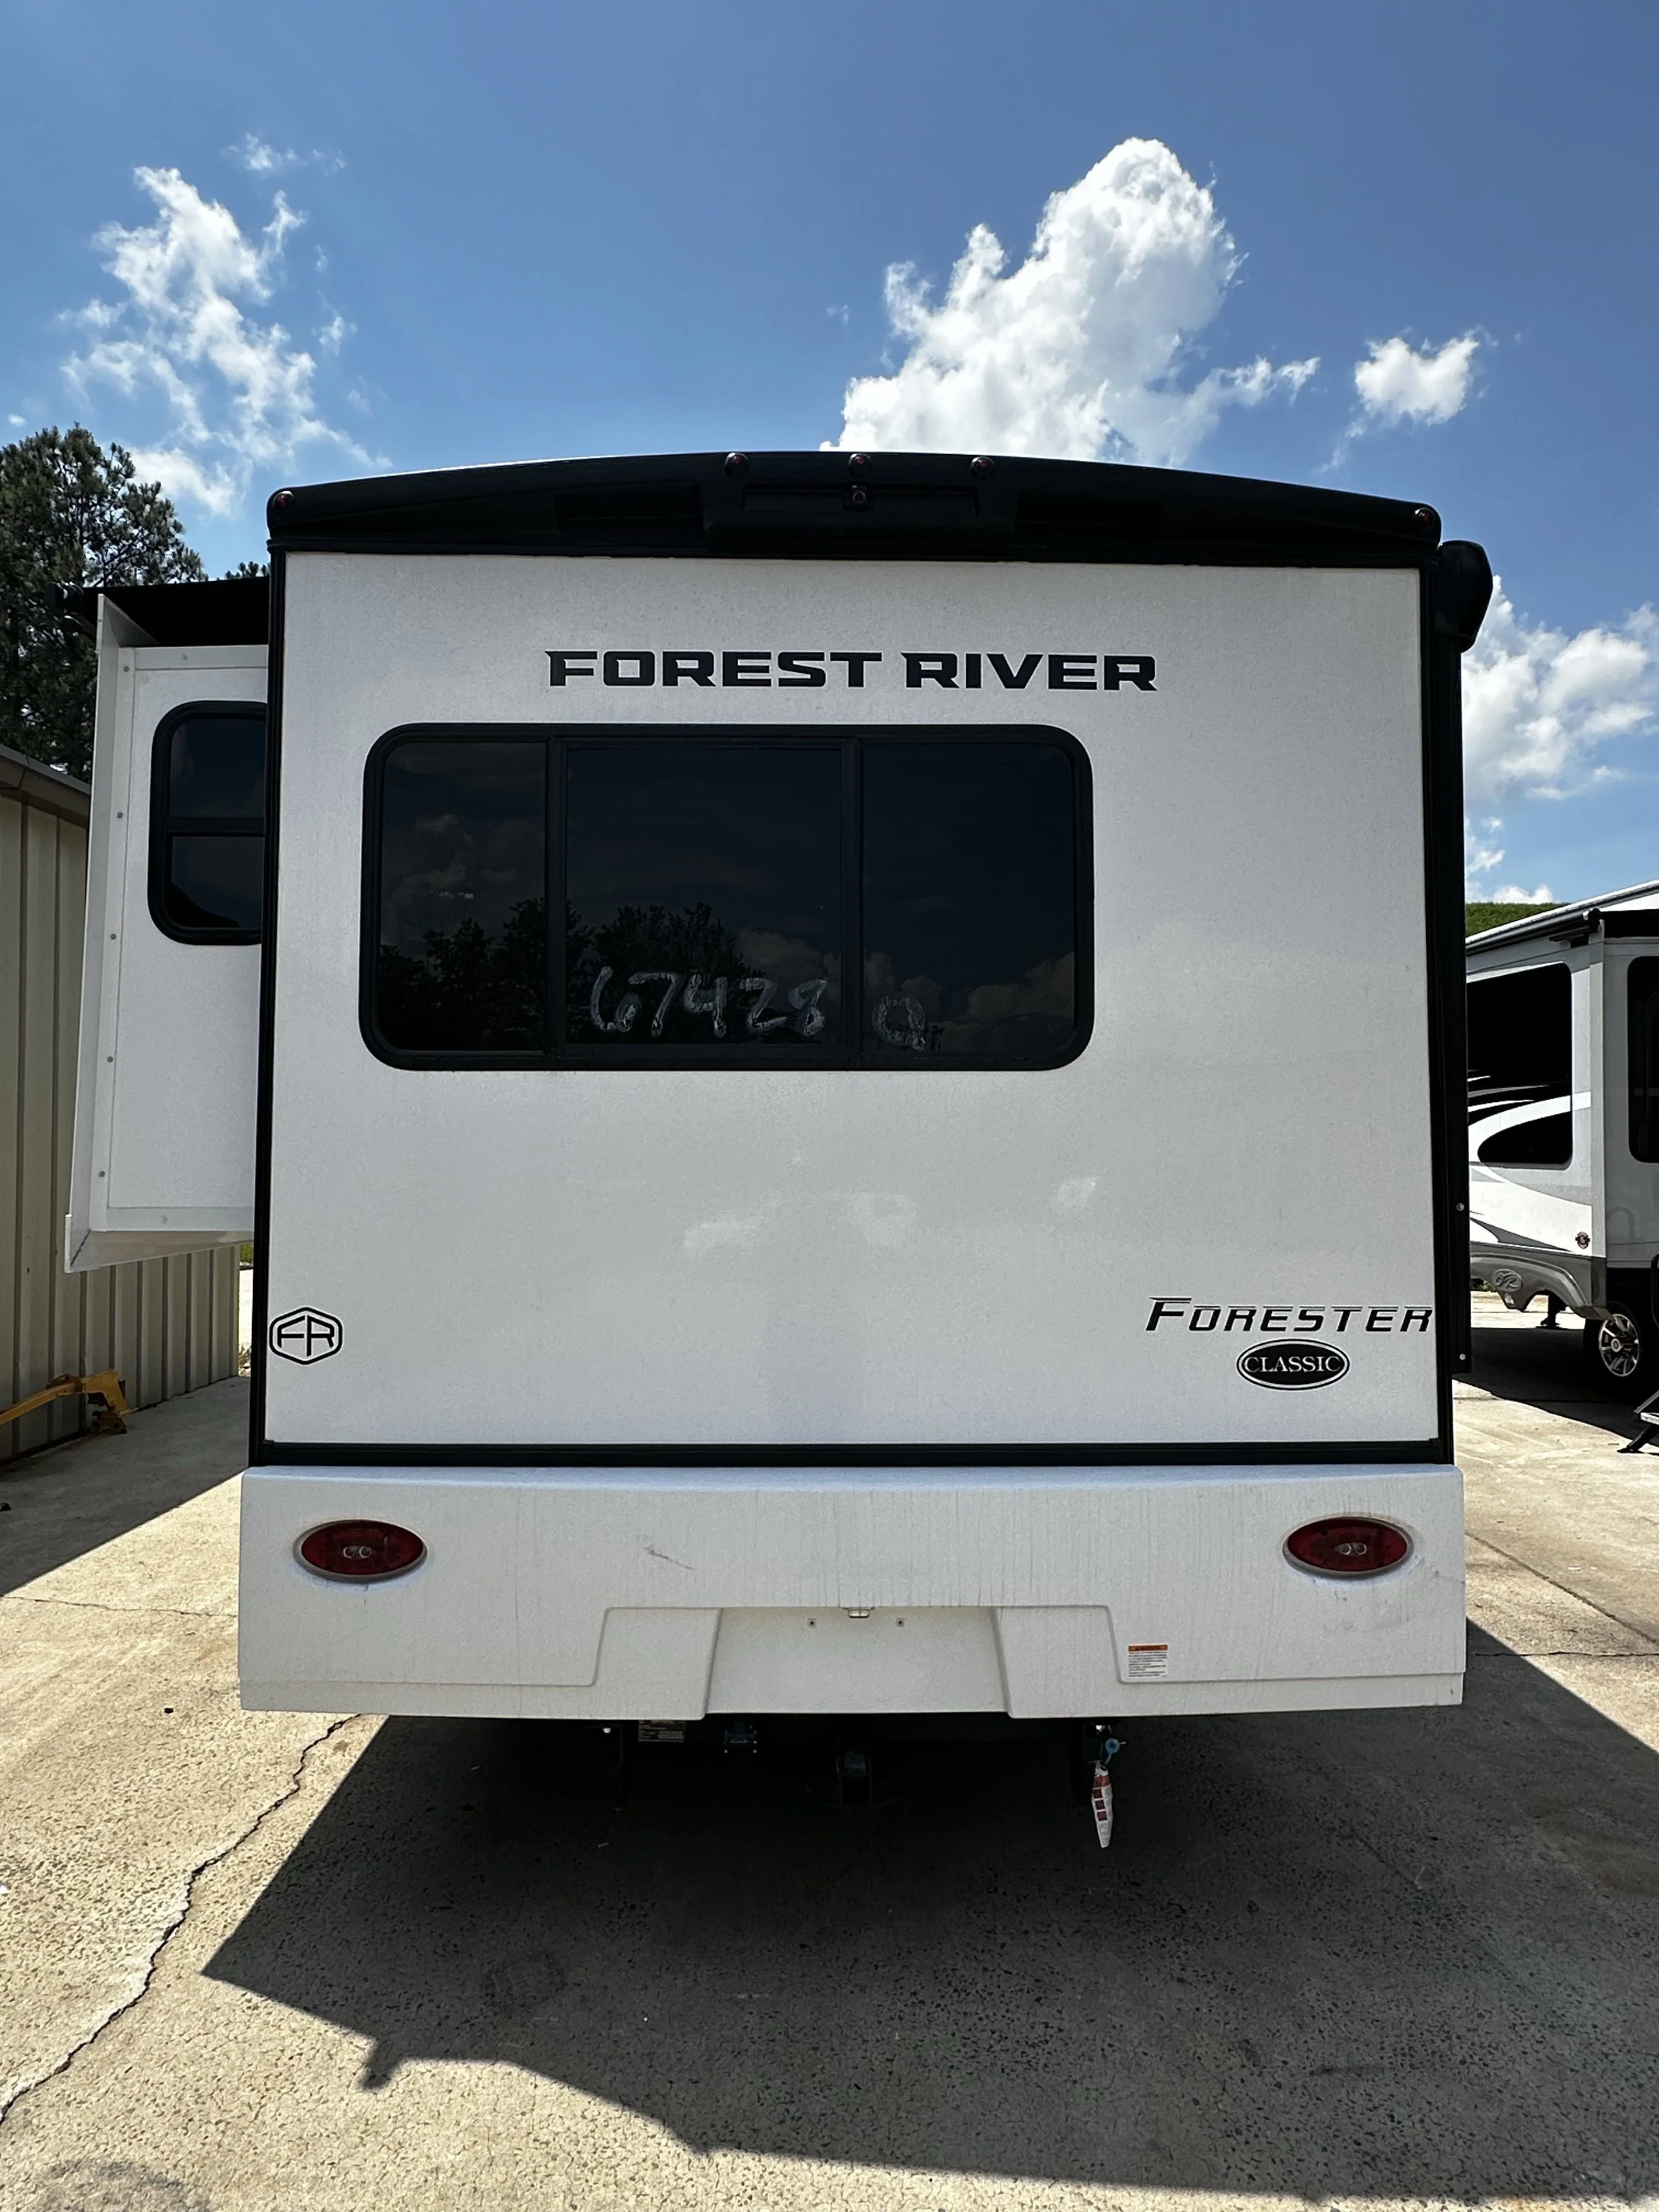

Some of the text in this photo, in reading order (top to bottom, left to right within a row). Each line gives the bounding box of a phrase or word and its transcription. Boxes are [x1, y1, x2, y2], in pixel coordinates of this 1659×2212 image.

[545, 651, 1158, 691] FOREST RIVER
[589, 966, 826, 1037] 67428
[1146, 1297, 1432, 1332] FORESTER
[1243, 1356, 1341, 1373] CLASSIC
